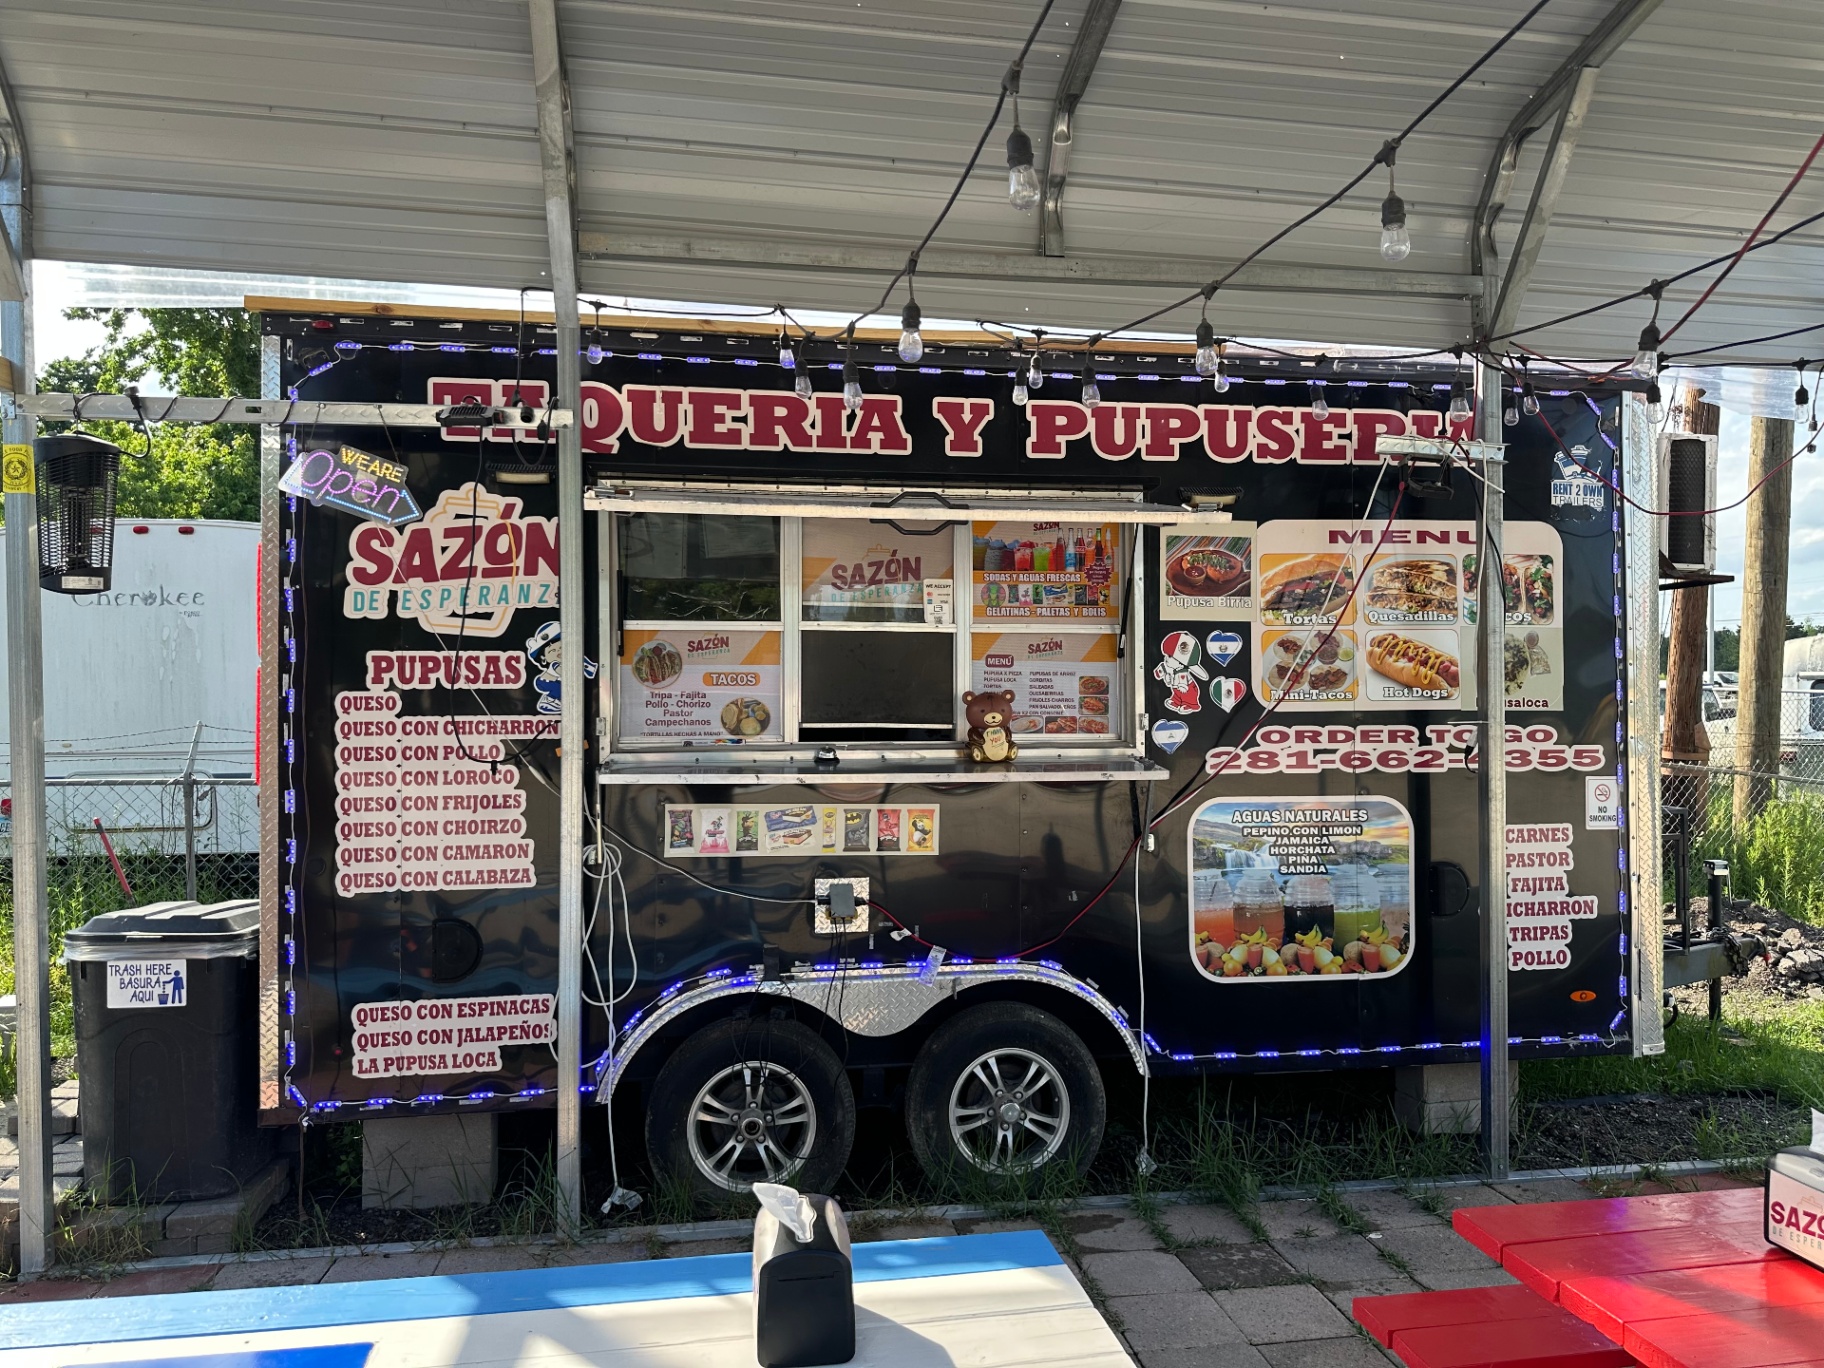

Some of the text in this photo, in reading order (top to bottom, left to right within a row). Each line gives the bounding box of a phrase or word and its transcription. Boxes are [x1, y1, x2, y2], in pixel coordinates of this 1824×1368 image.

[937, 402, 991, 453] Y
[300, 452, 400, 513] Open
[1553, 484, 1602, 497] RENT 2 OWN
[353, 503, 559, 585] SAZÓN
[831, 549, 921, 591] SAZÓN
[984, 573, 1010, 582] SODAS
[1012, 574, 1017, 582] Y
[1019, 574, 1044, 582] AGUAS
[1047, 574, 1081, 582] FRESCAS
[353, 583, 559, 612] DE ESPERANZ
[1167, 596, 1252, 609] Pupusa Birria
[986, 607, 1030, 616] GELATINAS
[1037, 608, 1070, 616] PALETAS
[1074, 608, 1079, 616] Y
[1083, 608, 1106, 616] BOLIS
[1283, 613, 1338, 625] Tortas
[1368, 611, 1454, 623] Quesadillas
[1505, 613, 1532, 622] cos
[688, 633, 729, 652] SAZÓN
[1028, 637, 1062, 654] SAZÓN
[988, 656, 1012, 665] MENÚ
[371, 655, 521, 685] PUPUSAS
[711, 673, 756, 685] TACOS
[650, 691, 672, 700] Tripa
[680, 691, 706, 700] Fajita
[1270, 690, 1351, 701] Mini-Tacos
[1383, 687, 1448, 699] Hot Dogs
[340, 696, 397, 714] QUESO
[646, 700, 668, 708] Pollo
[676, 700, 711, 708] Chorizo
[340, 720, 559, 740] QUESO CON CHICHARRON
[645, 718, 711, 727] Campechanos
[1260, 729, 1415, 744] ORDER
[1504, 729, 1554, 743] GO
[340, 745, 500, 765] QUESO CON POLLO
[1210, 748, 1603, 770] 281-662-355
[340, 770, 515, 790] QUESO CON LOROCO
[340, 794, 522, 816] QUESO CON FRIJOLES
[1598, 806, 1607, 814] NO
[1232, 809, 1368, 823] AGUAS NATURALES
[340, 819, 522, 841] QUESO CON CHOIRZO
[1243, 826, 1361, 836] PEPINO CON LIMON
[1506, 827, 1569, 843] CARNES
[1275, 836, 1329, 845] JAMAICA
[340, 844, 529, 866] QUESO CON CAMARON
[1270, 846, 1335, 855] HORCHATA
[1289, 854, 1318, 864] PIÑA
[1506, 852, 1570, 868] PASTOR
[1280, 865, 1327, 874] SANDIA
[340, 868, 531, 891] QUESO CON CALABAZA
[1511, 877, 1565, 896] FAJITA
[1507, 900, 1594, 917] ICHARRON
[1510, 925, 1569, 942] TRIPAS
[1512, 950, 1567, 966] POLLO
[109, 963, 172, 977] TRASH HERE
[119, 976, 161, 989] BASURA
[130, 990, 154, 1003] AQUI
[357, 998, 550, 1027] QUESO CON ESPINACAS
[357, 1021, 549, 1052] QUESO CON JALAPEÑOS
[358, 1052, 497, 1074] LA PUPUSA LOCA
